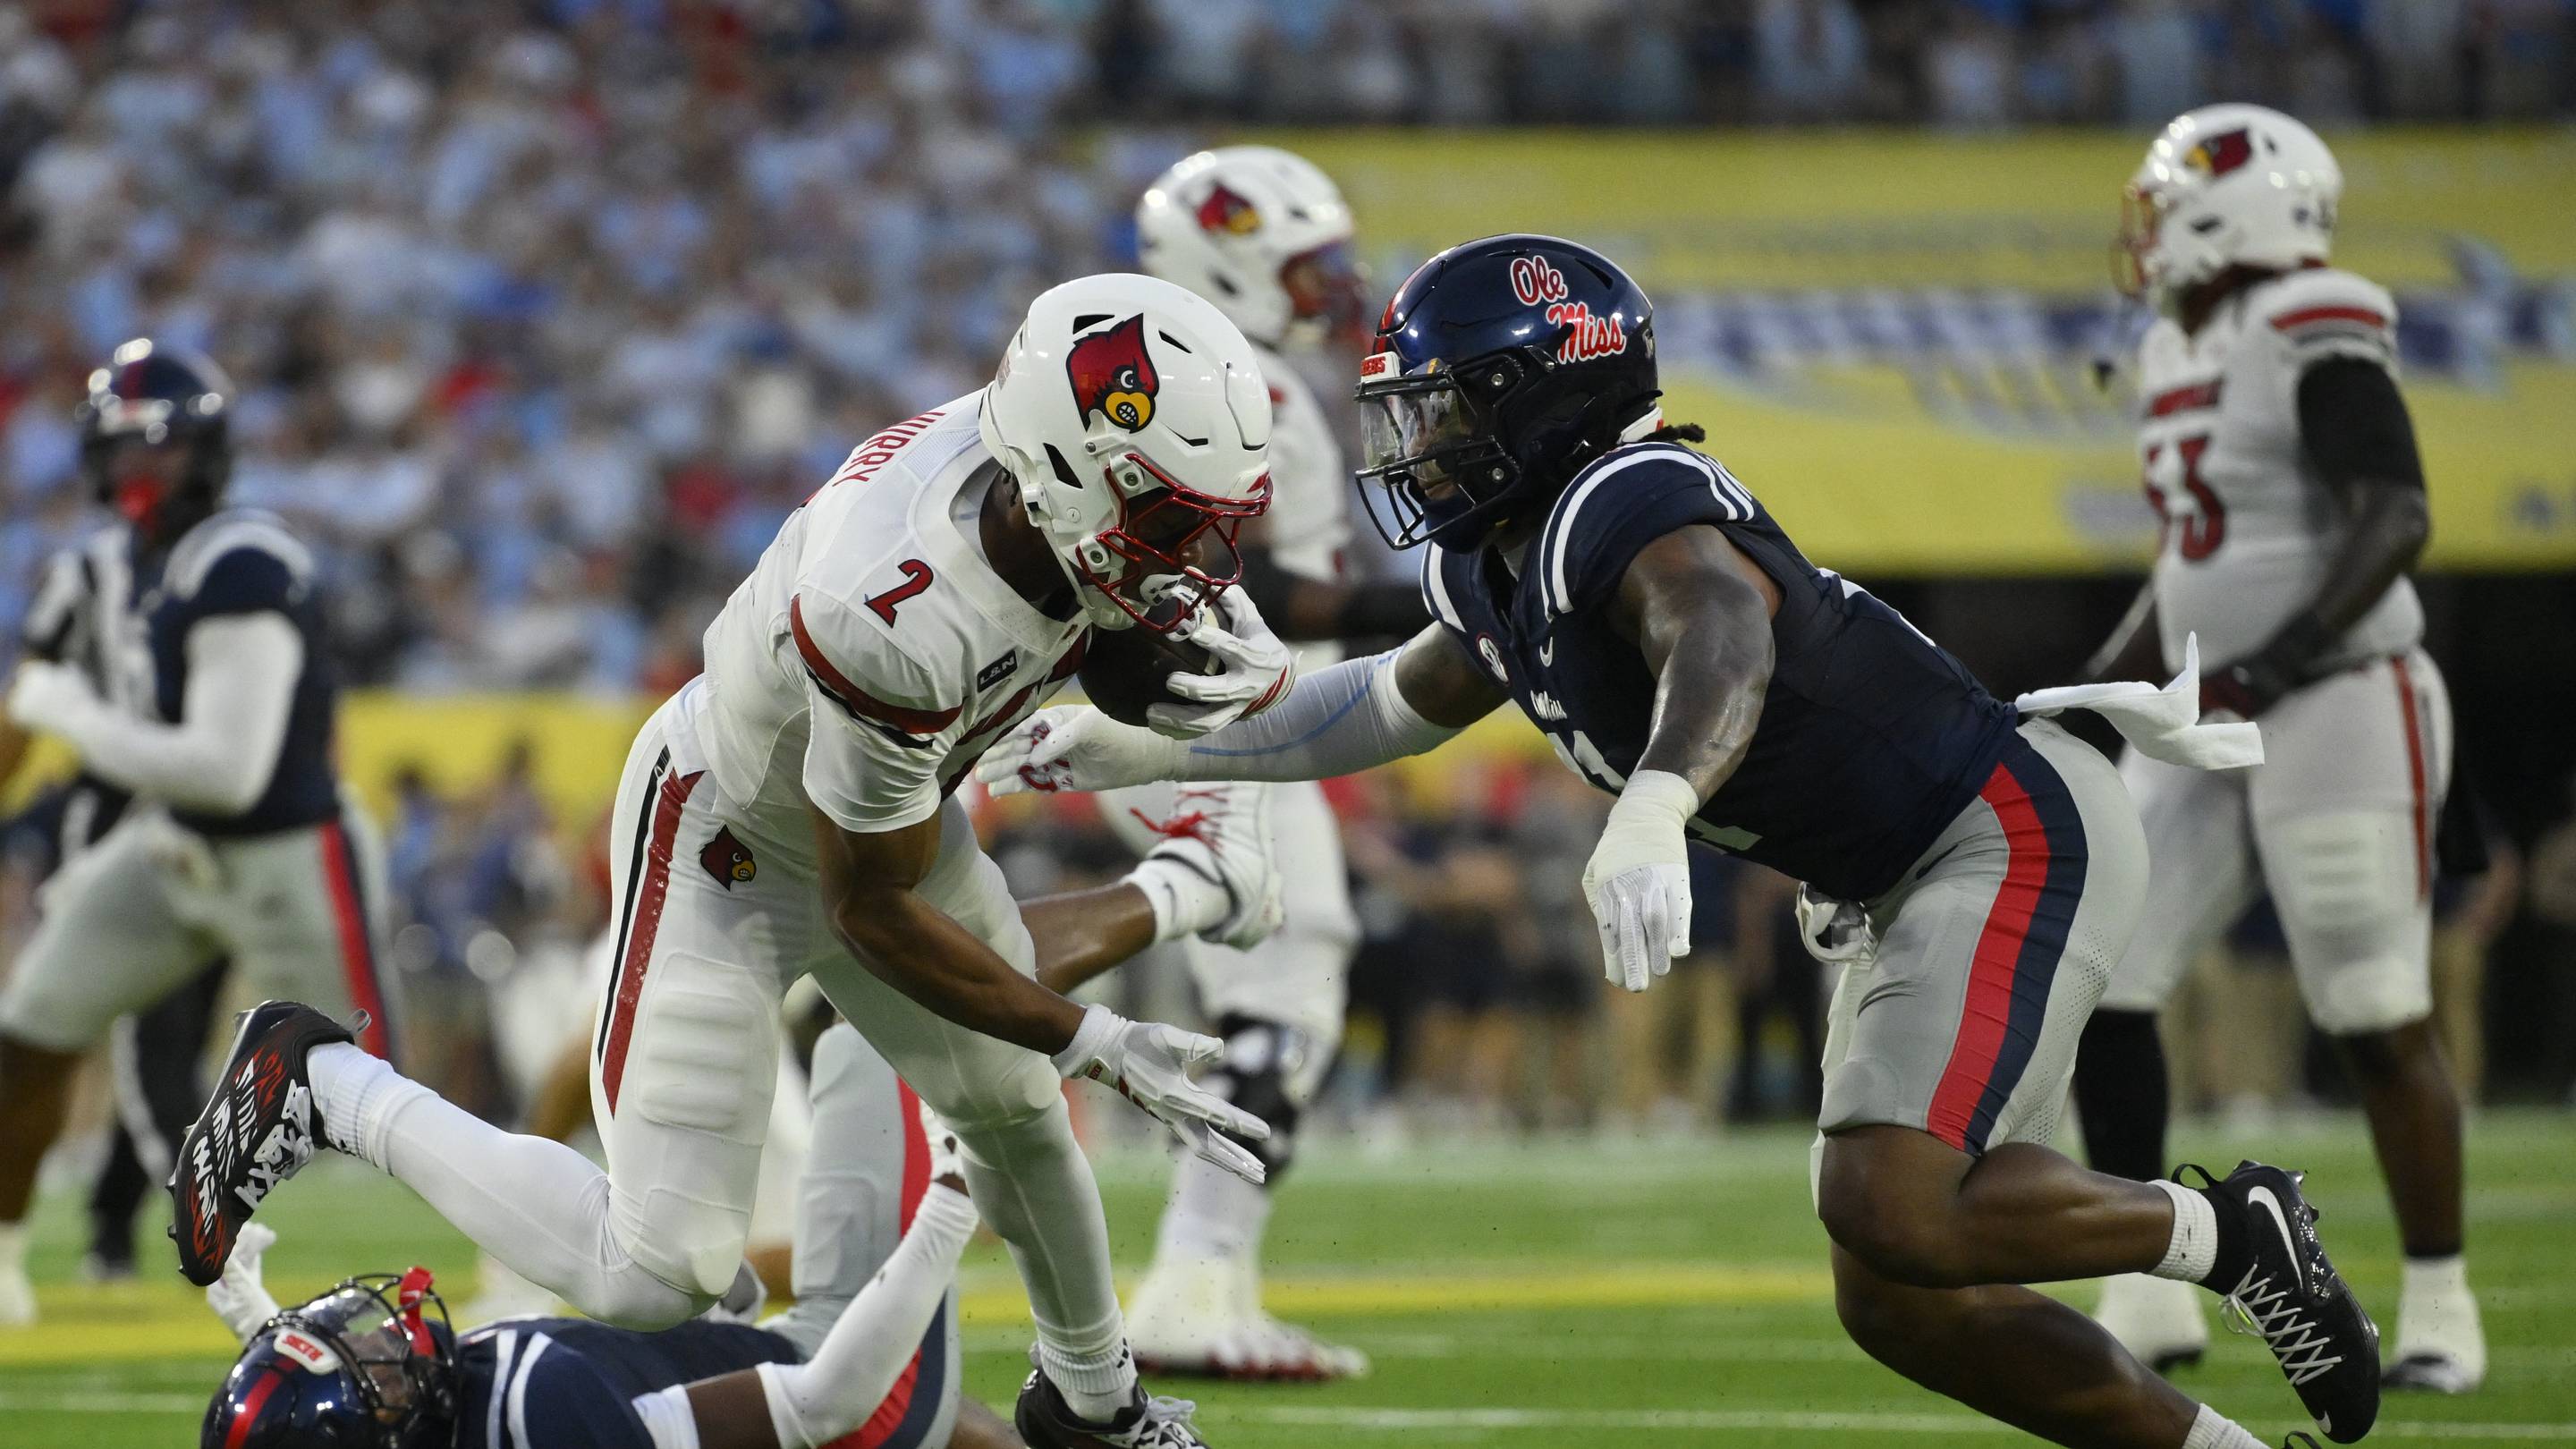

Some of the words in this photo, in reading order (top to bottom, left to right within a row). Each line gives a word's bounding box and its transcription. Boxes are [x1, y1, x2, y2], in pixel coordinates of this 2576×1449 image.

[1510, 255, 1567, 306] Ole
[1546, 301, 1627, 365] Miss
[864, 558, 934, 628] 2
[979, 655, 1015, 686] L&N
